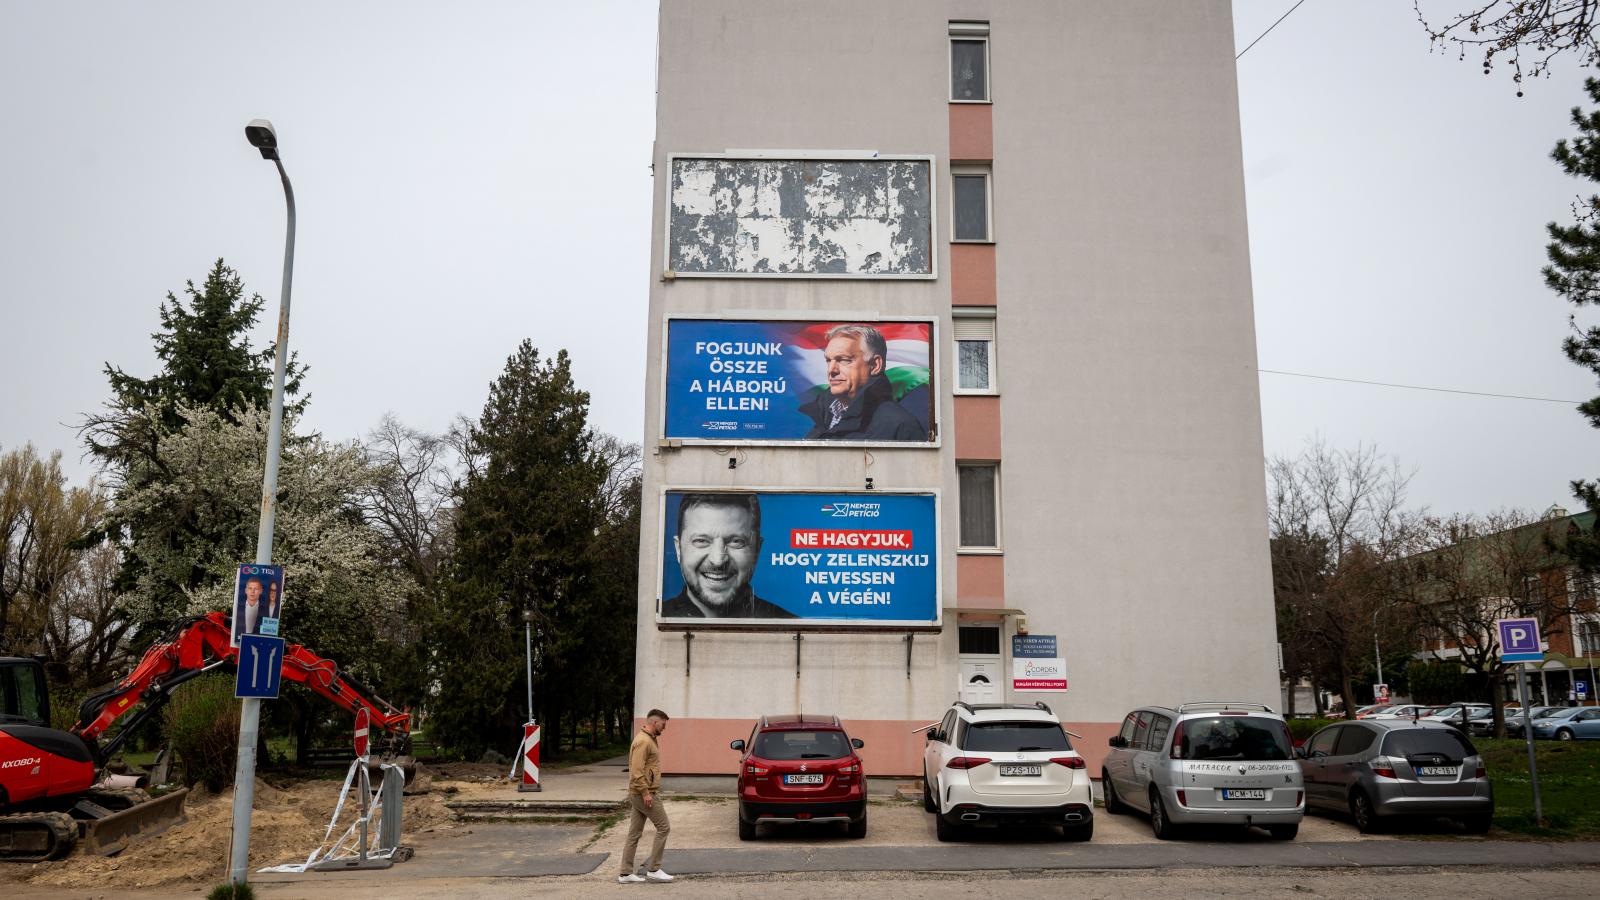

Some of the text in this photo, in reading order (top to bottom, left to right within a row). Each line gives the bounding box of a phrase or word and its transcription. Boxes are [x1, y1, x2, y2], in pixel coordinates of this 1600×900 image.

[695, 341, 783, 356] FOGJUNK
[709, 357, 768, 374] ÖSSZE
[689, 376, 786, 394] A HÁBORÚ
[706, 397, 769, 411] ELLEN!
[848, 509, 880, 517] PETÍCIÓ
[795, 532, 910, 548] NE HAGYJUK,
[771, 553, 929, 567] HOGY ZELENSZKIJ
[805, 571, 895, 584] NEVESSEN
[809, 588, 891, 605] A VÉGÉN!
[1510, 628, 1527, 647] P
[1, 757, 41, 769] KX080-4
[1006, 766, 1040, 774] PZS-101
[789, 775, 822, 783] SNF-675
[1228, 788, 1264, 799] MCM-144
